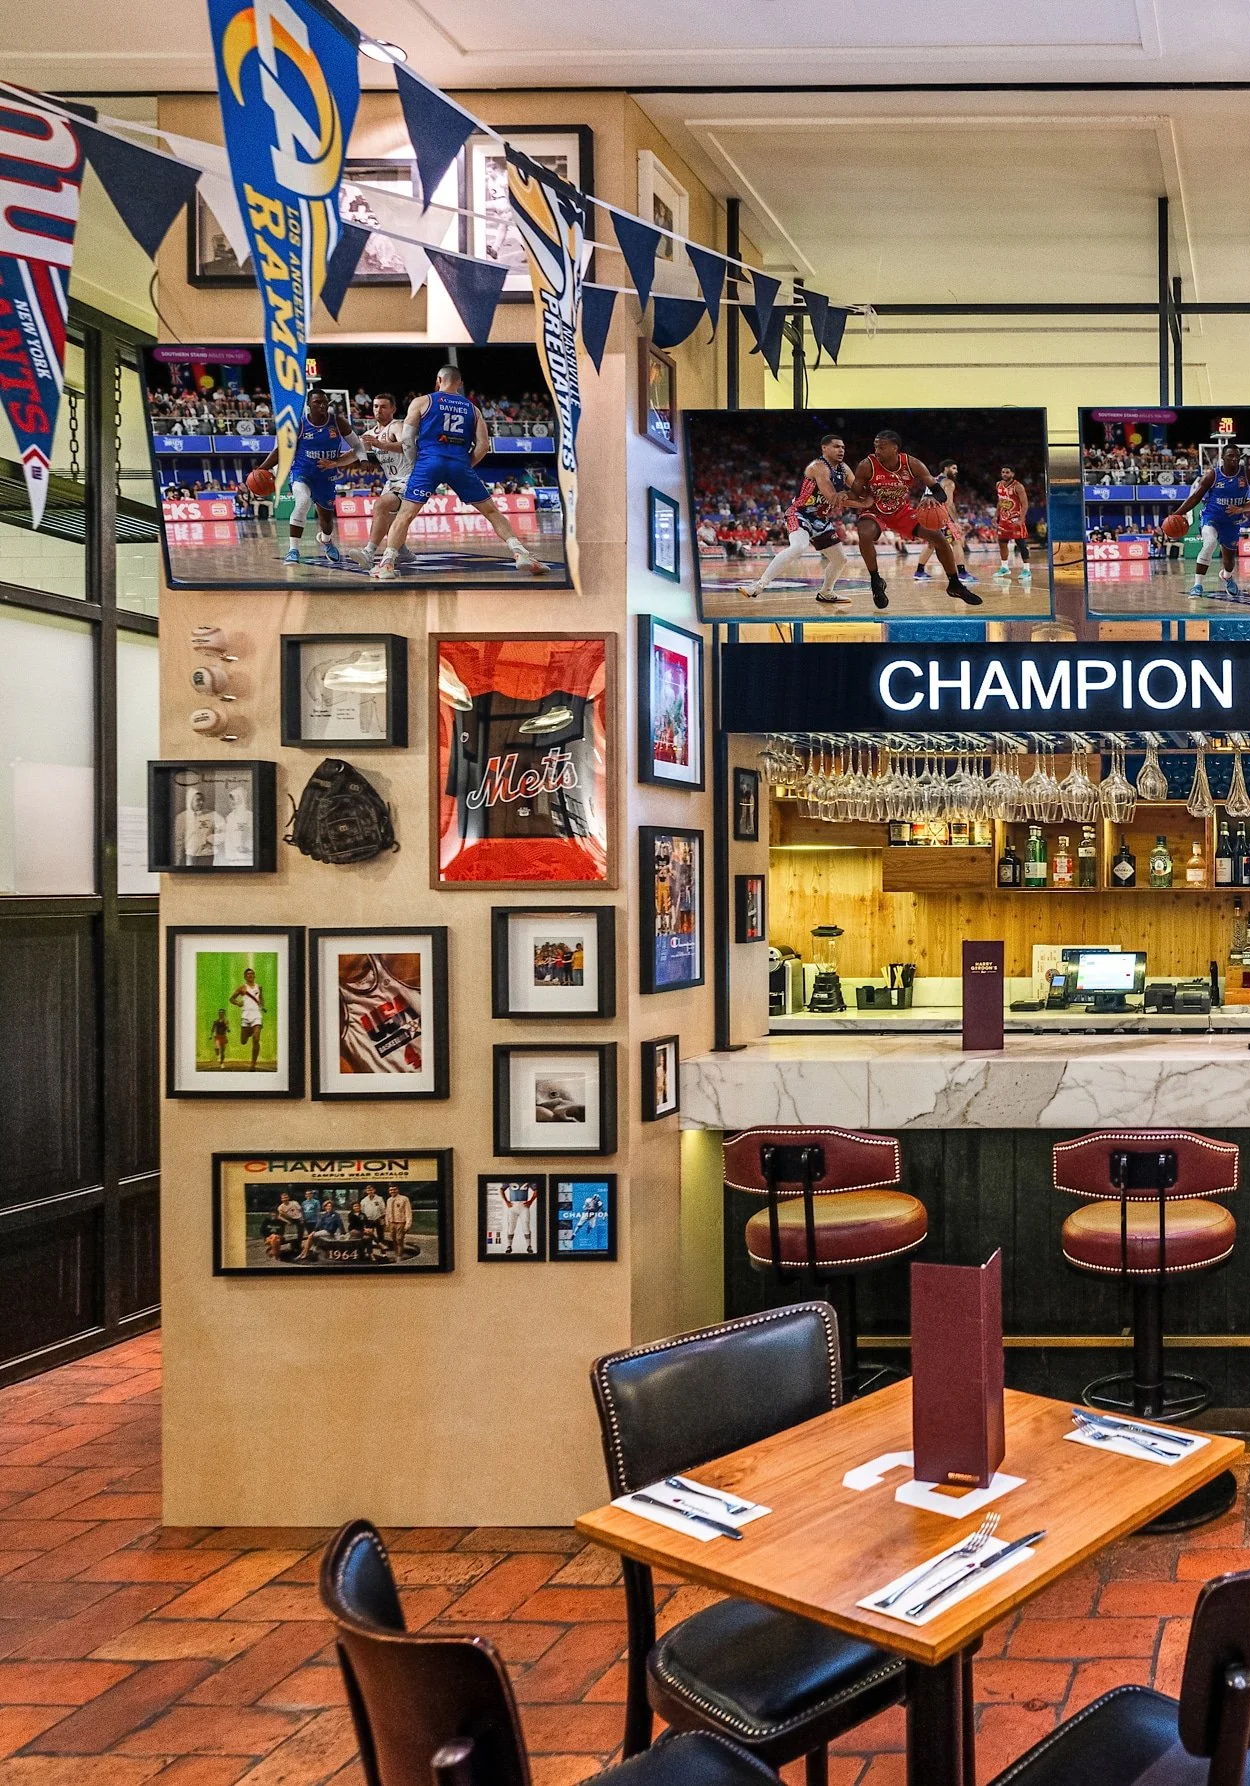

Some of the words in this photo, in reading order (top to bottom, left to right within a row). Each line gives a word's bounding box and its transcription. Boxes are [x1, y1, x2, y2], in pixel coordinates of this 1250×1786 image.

[286, 205, 302, 247] LOS
[243, 182, 304, 396] RAMS
[14, 299, 39, 337] NEW
[27, 338, 53, 380] YORK
[541, 289, 577, 473] PREDATORS
[562, 320, 582, 408] NASHVILLE
[439, 404, 468, 415] BAYNES
[443, 413, 464, 433] 12
[1219, 422, 1233, 433] 20
[877, 659, 1235, 712] CHAMPION
[466, 746, 580, 810] Mets
[360, 994, 421, 1042] USA
[243, 1158, 409, 1174] CHAMPION
[328, 1250, 358, 1260] 1964
